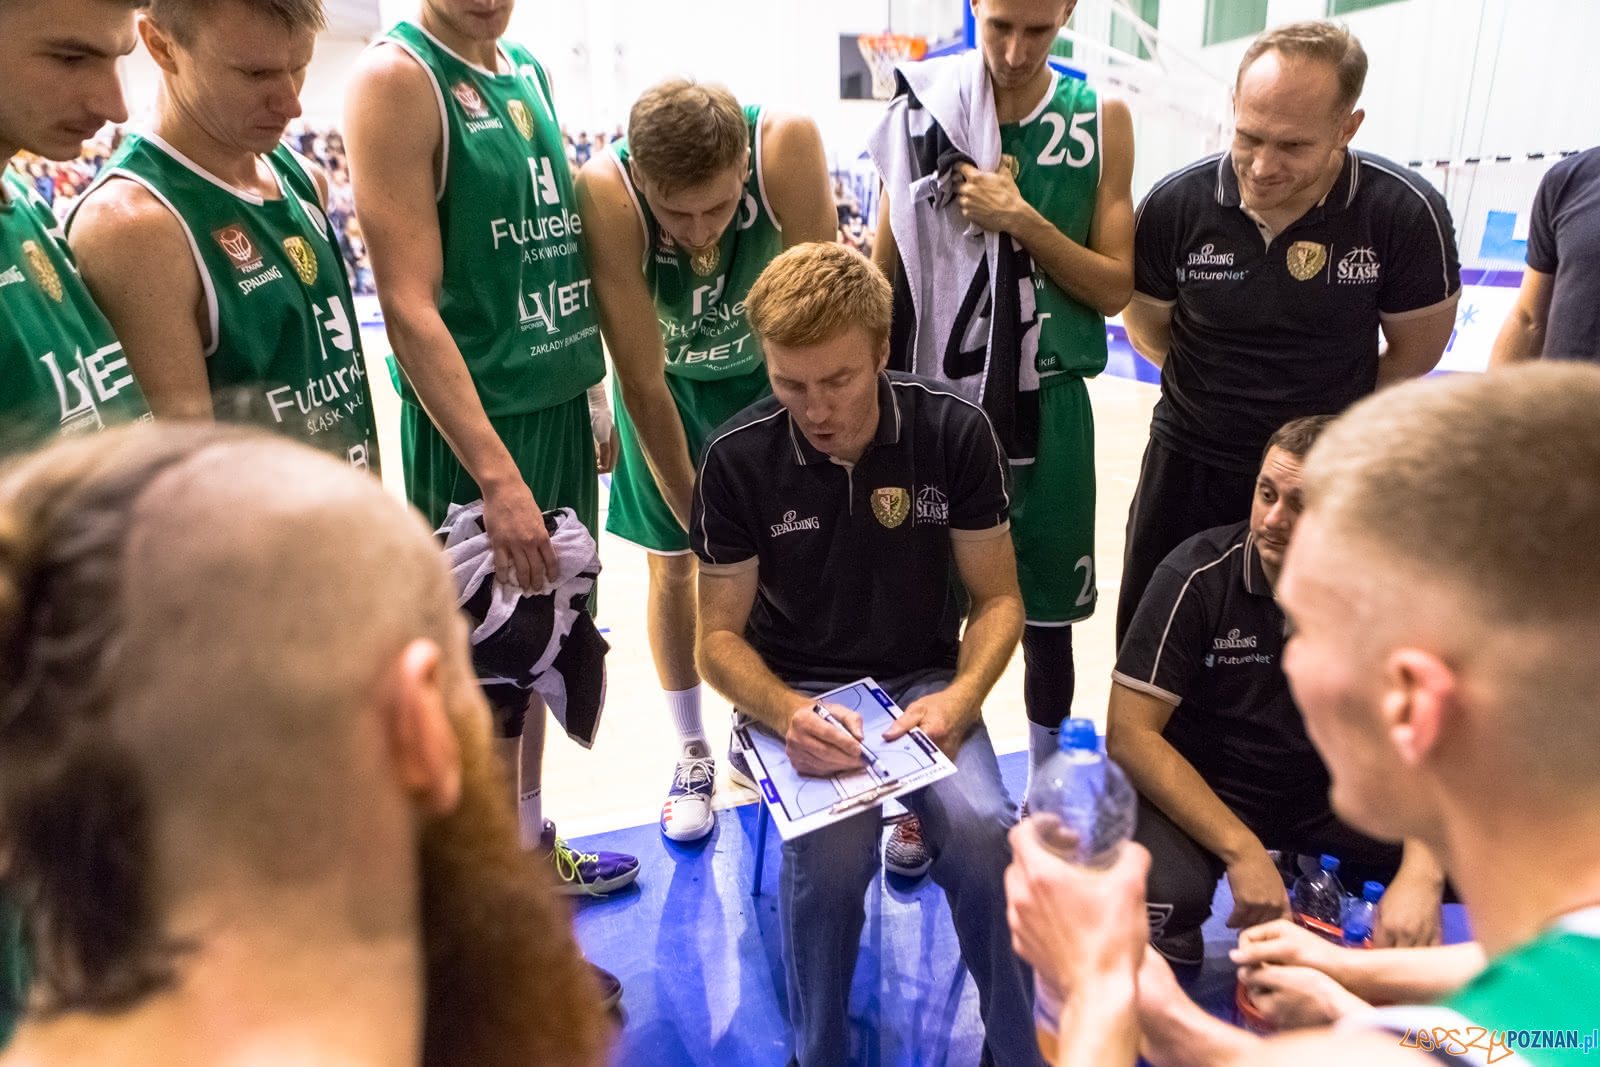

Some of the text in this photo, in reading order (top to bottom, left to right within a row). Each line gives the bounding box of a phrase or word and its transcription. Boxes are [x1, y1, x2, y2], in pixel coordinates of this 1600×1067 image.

[1036, 111, 1097, 168] 25
[1187, 252, 1234, 266] SPALDING
[238, 264, 283, 296] SPALDING
[1188, 267, 1248, 282] FutureNet
[685, 332, 751, 364] BET
[770, 514, 820, 538] SPALDING
[1073, 555, 1098, 607] 2
[1217, 653, 1270, 665] FutureNet
